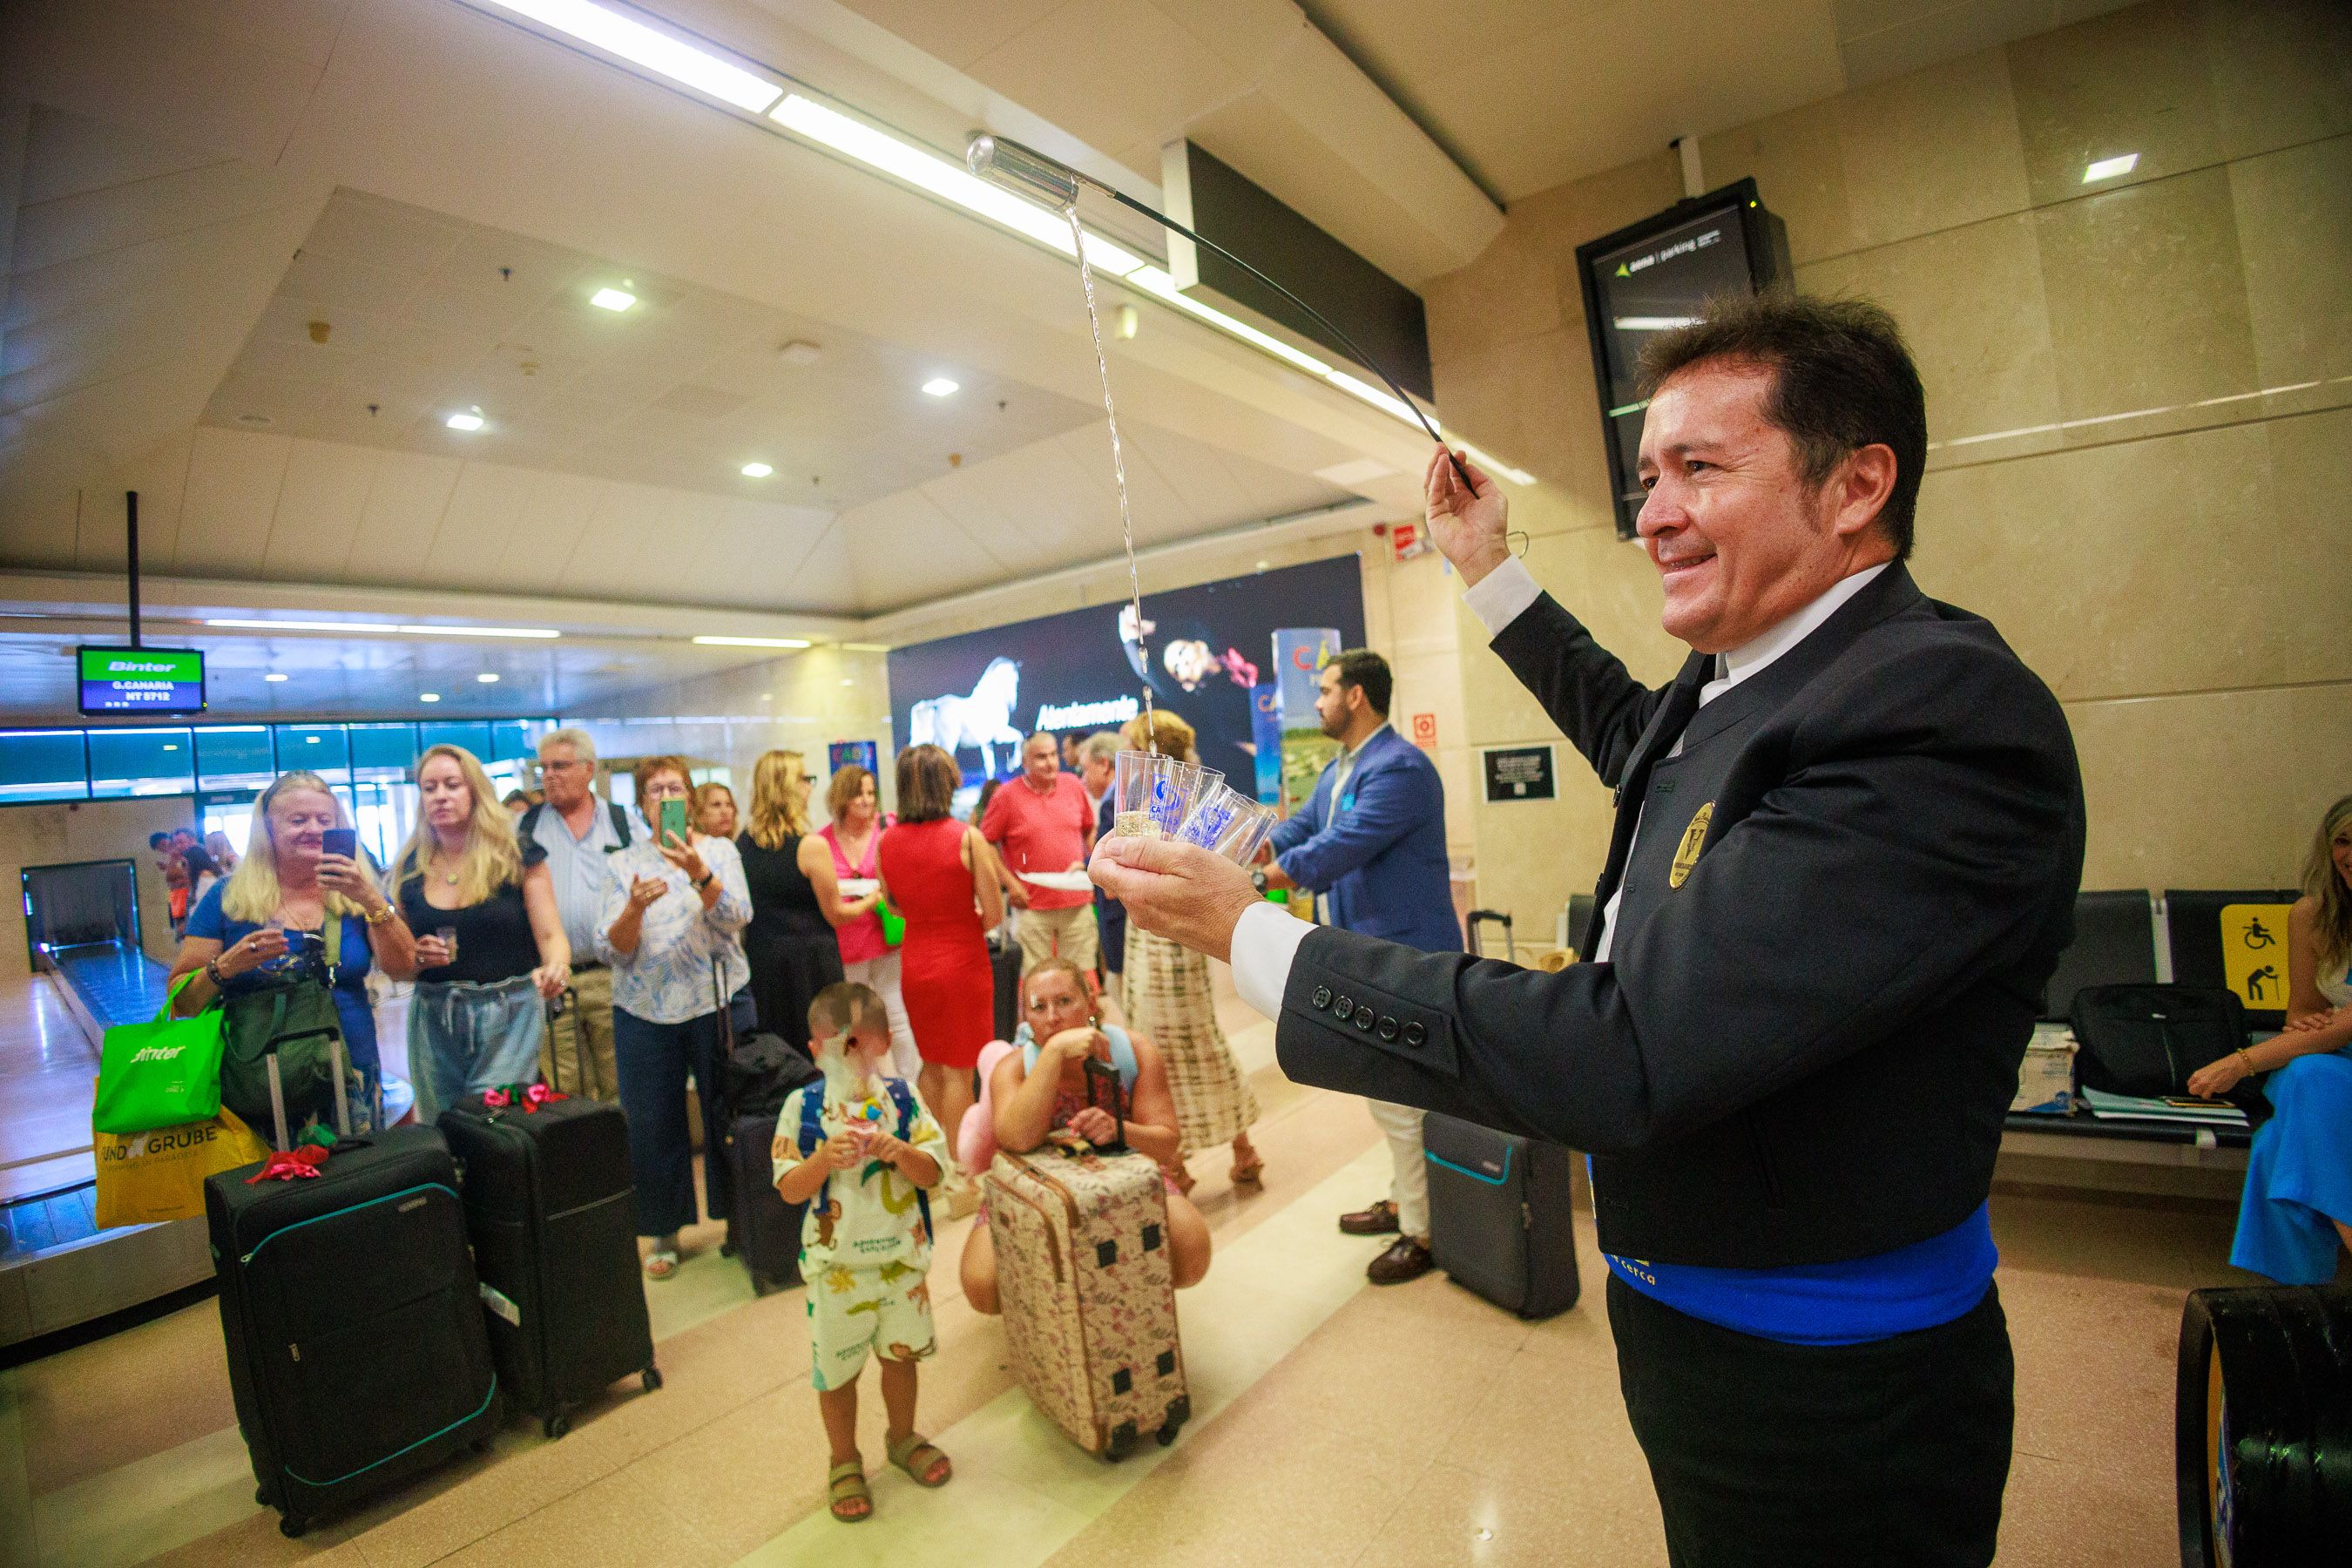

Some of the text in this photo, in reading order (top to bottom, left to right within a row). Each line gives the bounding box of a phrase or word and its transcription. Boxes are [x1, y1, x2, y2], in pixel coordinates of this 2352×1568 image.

[1659, 238, 1697, 262] parking
[108, 660, 176, 672] Binter
[1035, 694, 1139, 732] Atentamente
[147, 1125, 218, 1154] GRUBE
[1621, 1260, 1656, 1286] cerca
